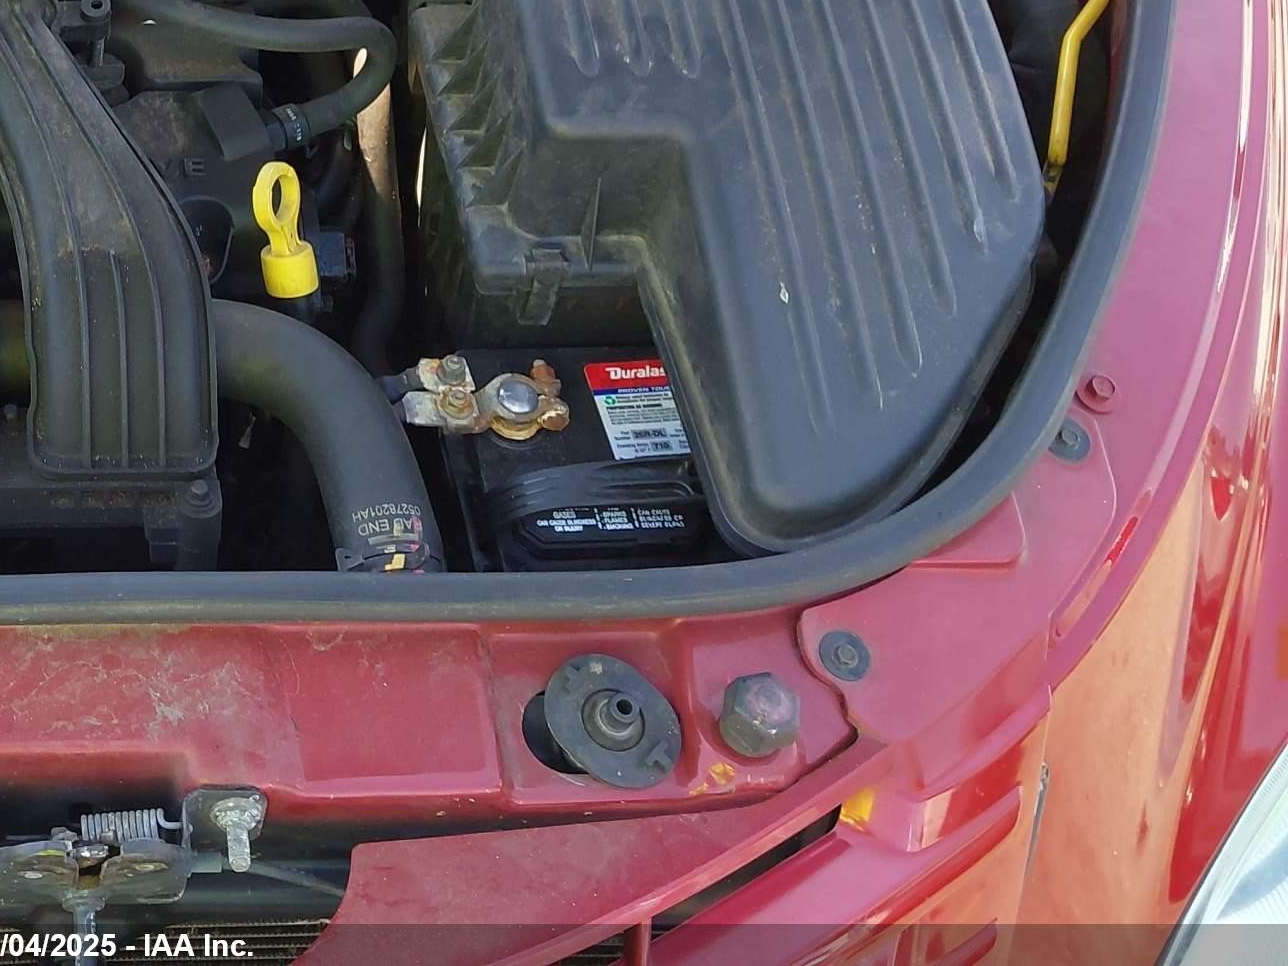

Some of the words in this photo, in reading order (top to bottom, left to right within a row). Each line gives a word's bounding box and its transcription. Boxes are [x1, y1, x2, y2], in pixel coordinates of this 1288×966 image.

[604, 365, 666, 380] Duralas
[352, 503, 421, 522] 05278201AH
[358, 518, 390, 536] END
